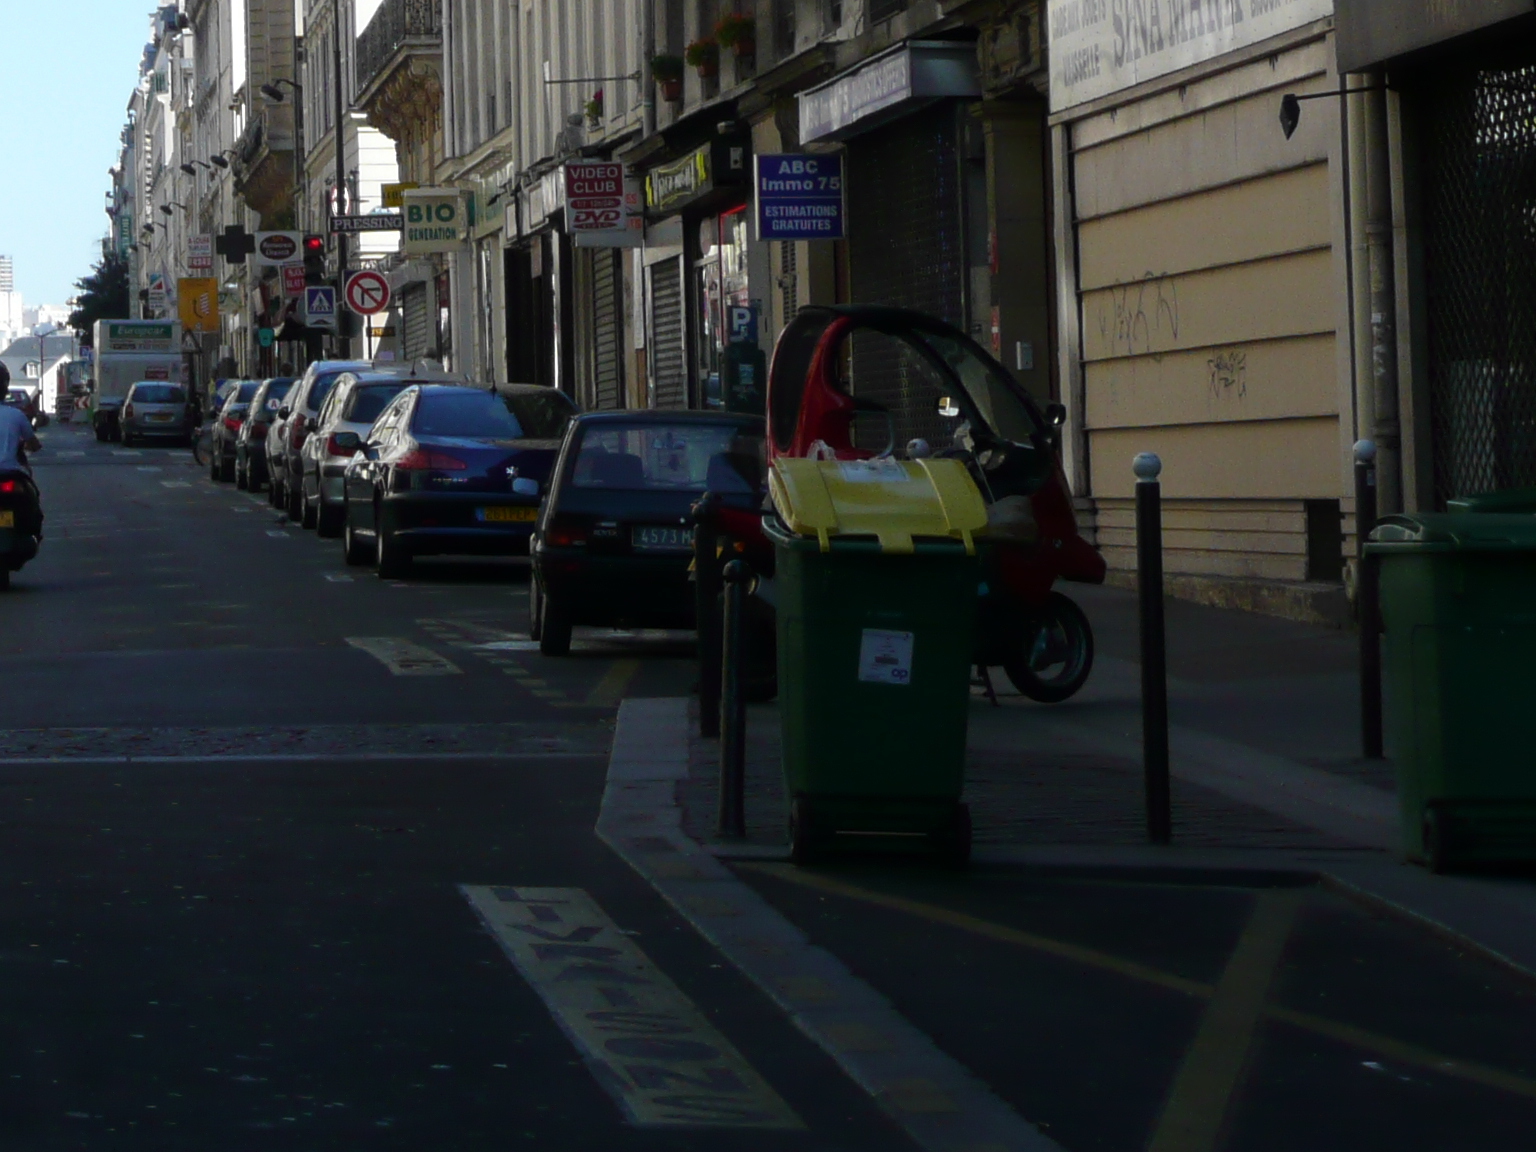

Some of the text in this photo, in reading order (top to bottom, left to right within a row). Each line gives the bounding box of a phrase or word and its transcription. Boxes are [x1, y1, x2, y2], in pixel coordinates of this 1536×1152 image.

[570, 166, 618, 179] VIDEO
[778, 160, 818, 174] ABC
[573, 181, 616, 193] CLUB
[762, 177, 840, 190] Immo 75
[408, 203, 455, 223] BIO
[573, 210, 621, 223] DVD
[765, 206, 838, 217] ESTIMATIONS
[332, 217, 403, 229] PRESSING
[771, 219, 831, 230] GRATUITES
[408, 227, 456, 241] GENERATION
[733, 308, 751, 331] P
[641, 529, 677, 544] 4573
